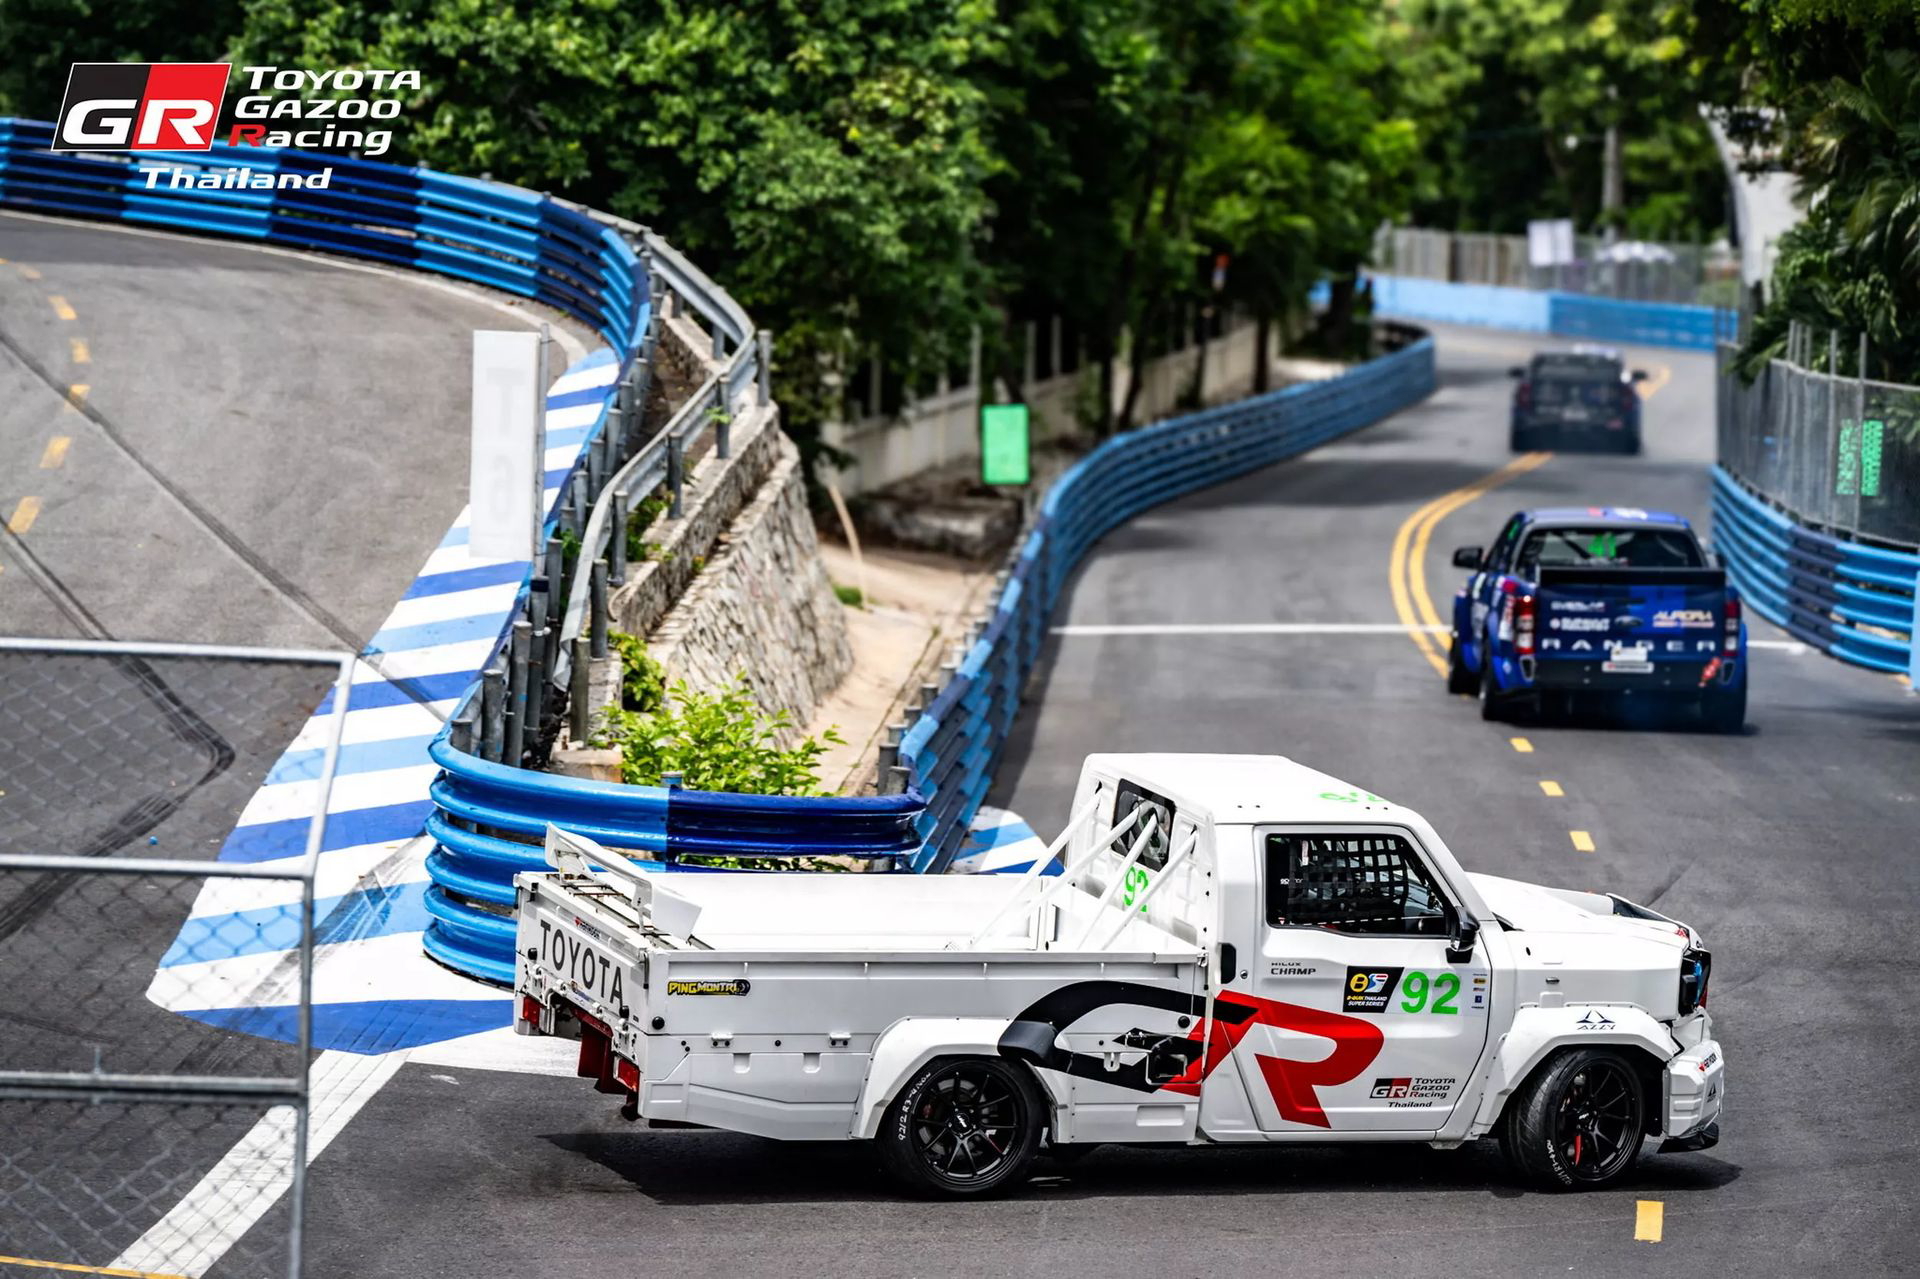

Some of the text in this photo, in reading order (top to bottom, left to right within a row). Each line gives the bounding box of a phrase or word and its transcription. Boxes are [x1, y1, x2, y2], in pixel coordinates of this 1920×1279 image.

[1542, 638, 1716, 651] RANGER
[540, 919, 624, 1010] TOYOTA
[1401, 971, 1461, 1015] 92
[1371, 1085, 1408, 1098] GR
[1409, 1091, 1447, 1099] Racing
